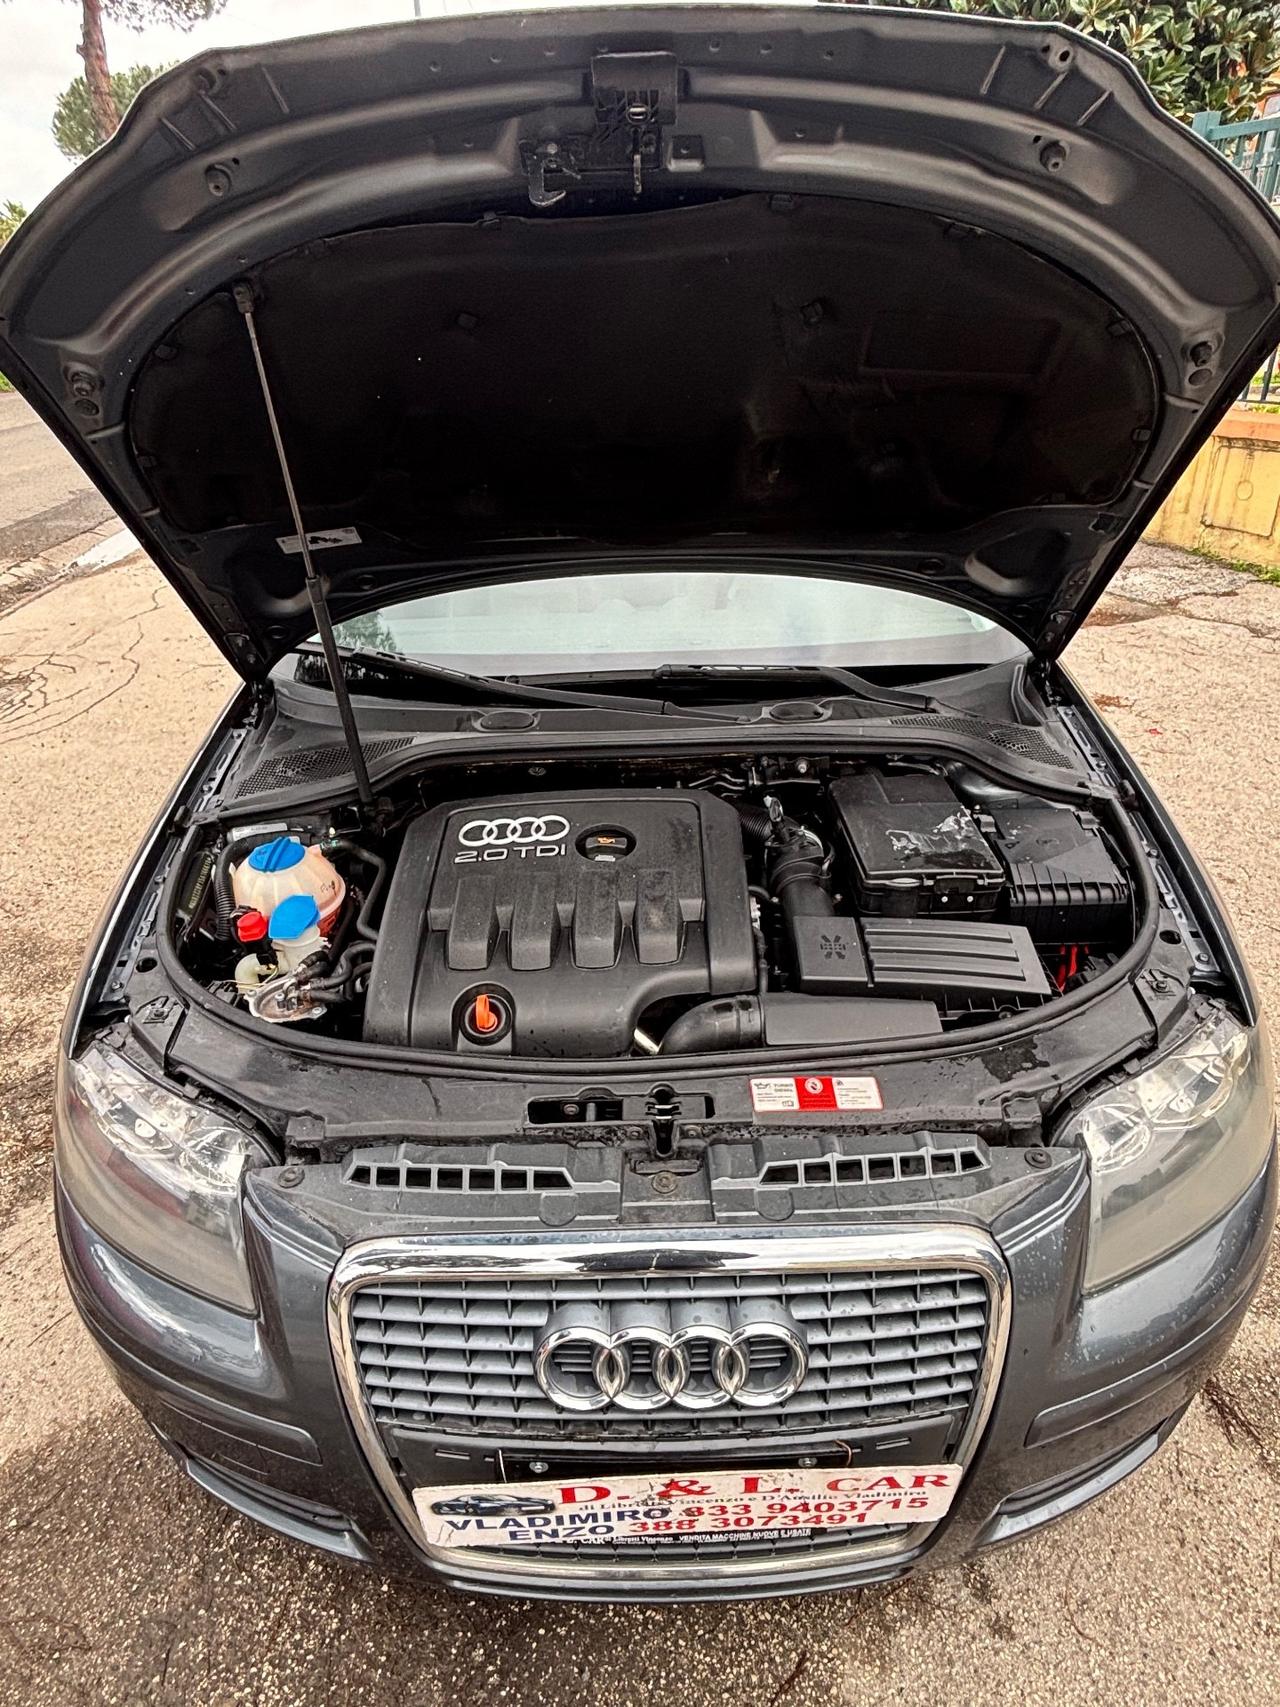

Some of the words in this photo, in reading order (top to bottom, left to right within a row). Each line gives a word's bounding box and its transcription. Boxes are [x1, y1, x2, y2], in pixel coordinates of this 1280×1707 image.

[454, 848, 508, 864] 2.0
[513, 843, 566, 859] TDI
[656, 1479, 716, 1497] &
[826, 1474, 951, 1492] CAR
[446, 1507, 670, 1531] VLADIMIRO
[767, 1497, 929, 1514] 9403715
[509, 1524, 615, 1542] ENZO
[629, 1518, 699, 1533] 388
[711, 1512, 867, 1529] 3073491
[679, 1534, 711, 1542] VENDITA
[711, 1532, 753, 1541] MACCHINE
[753, 1530, 779, 1539] NUOVE
